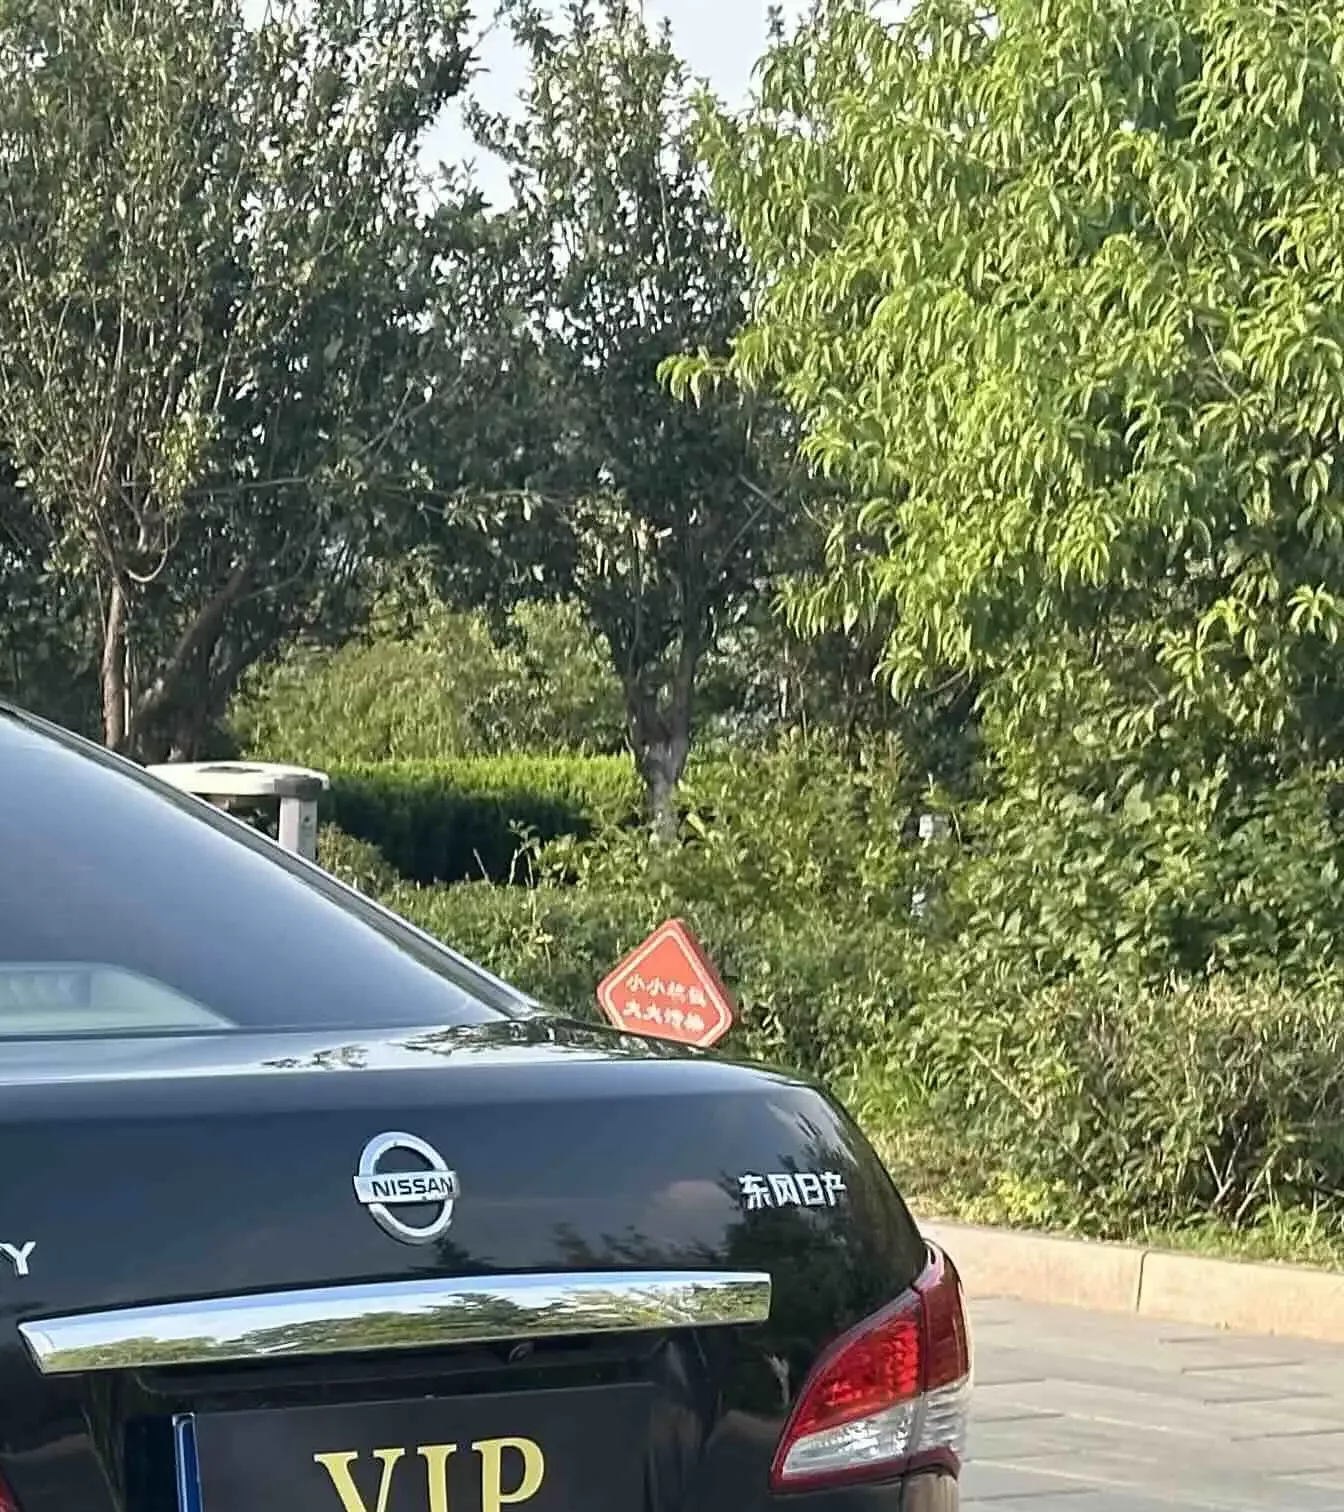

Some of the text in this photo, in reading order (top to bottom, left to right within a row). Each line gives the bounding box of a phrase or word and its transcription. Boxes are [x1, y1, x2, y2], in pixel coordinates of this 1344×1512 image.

[371, 1176, 454, 1197] NISSAN
[738, 1171, 847, 1210] 东风日产
